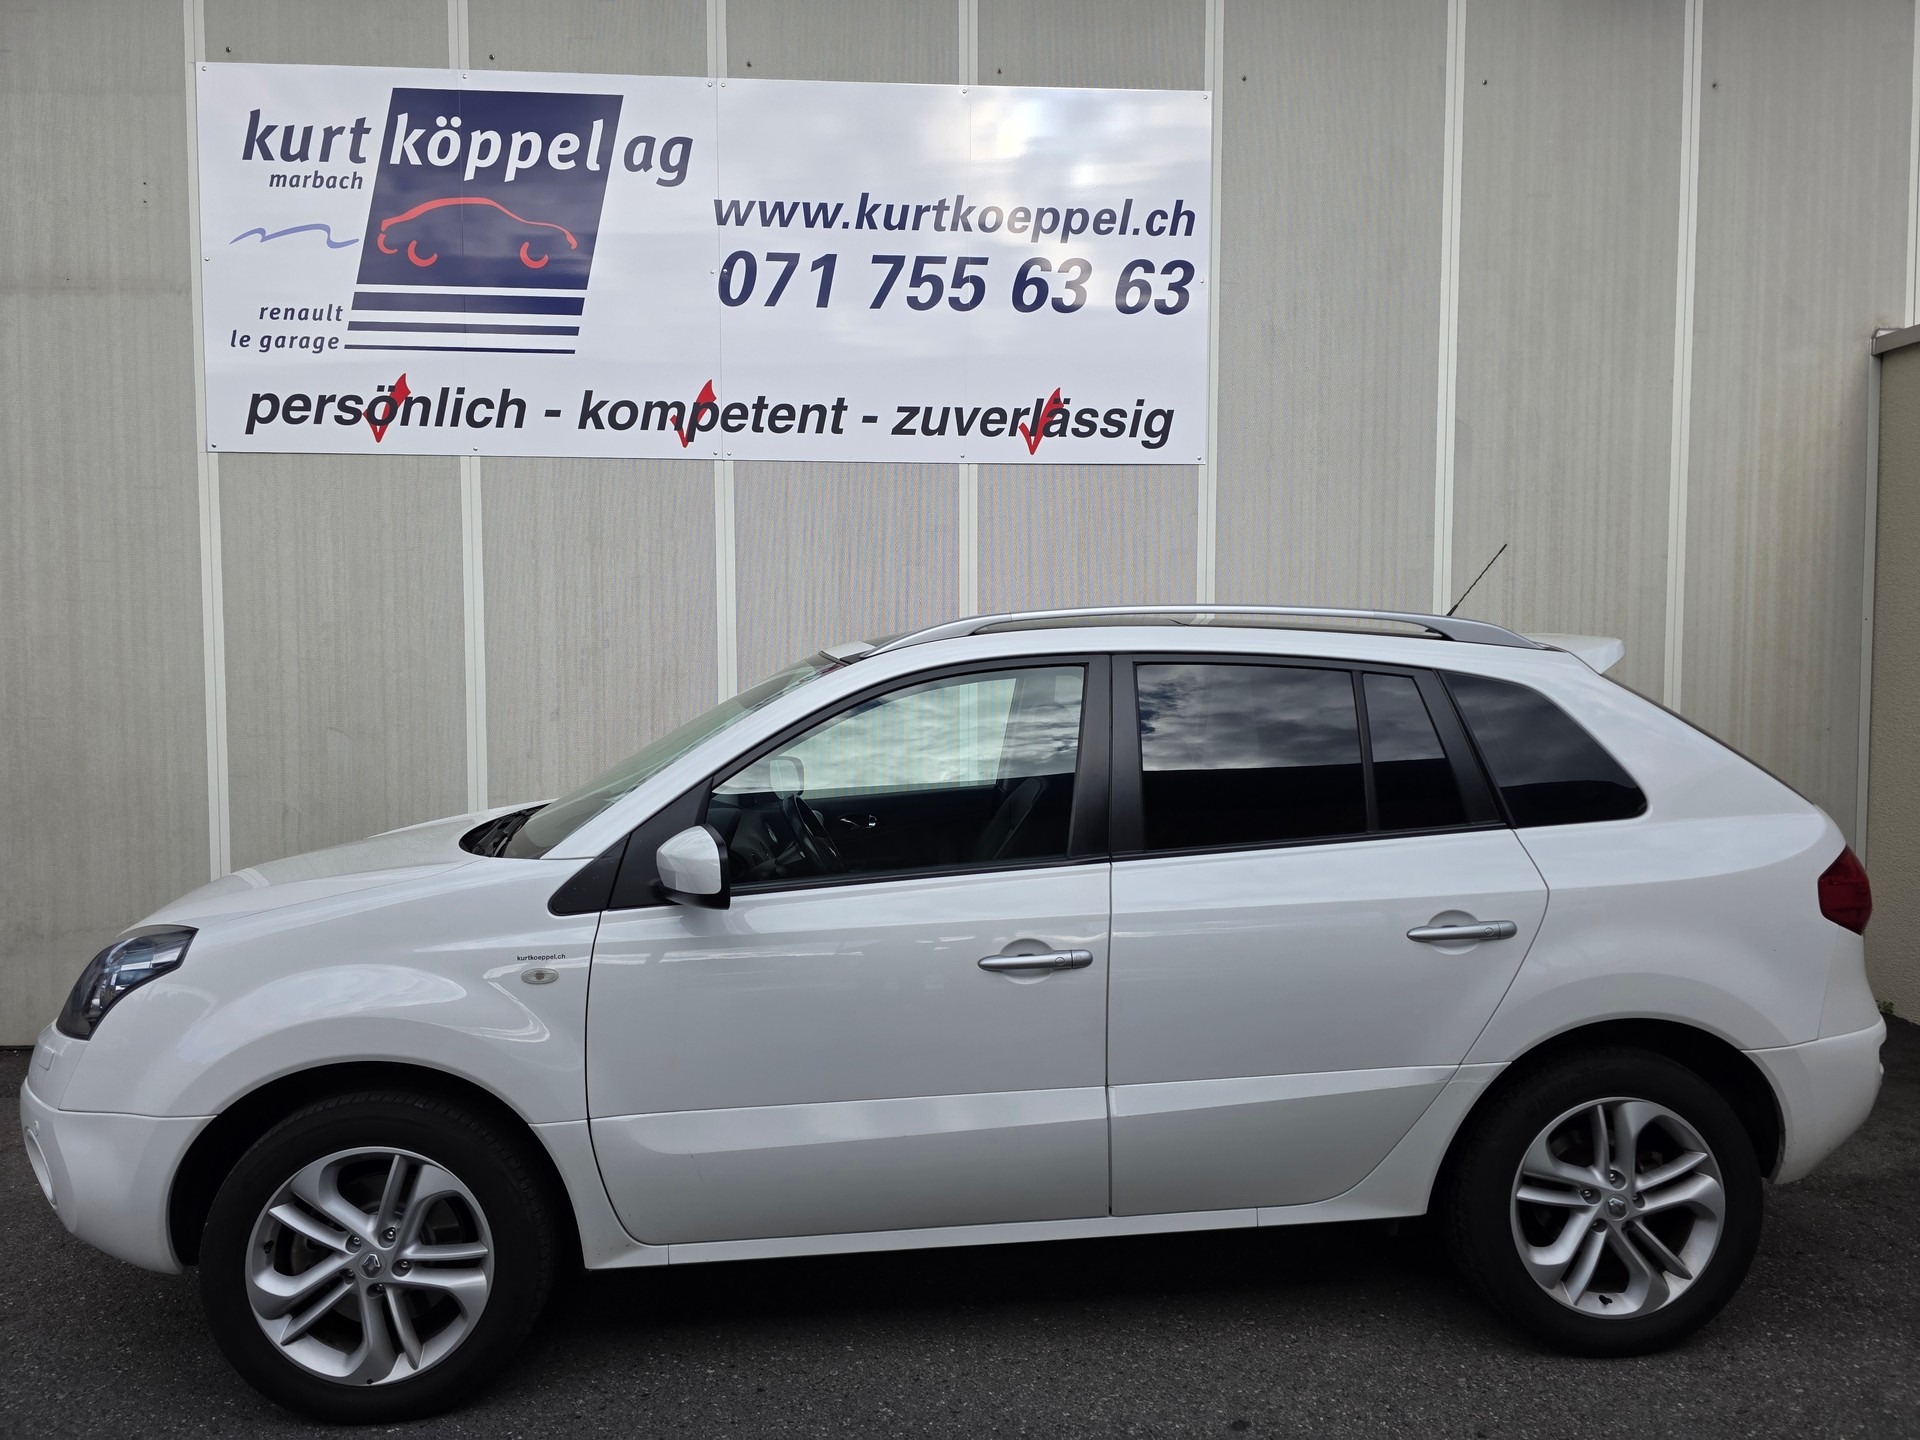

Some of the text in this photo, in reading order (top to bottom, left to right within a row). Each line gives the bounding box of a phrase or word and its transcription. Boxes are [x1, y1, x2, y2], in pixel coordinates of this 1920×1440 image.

[242, 109, 693, 187] kurt köppel ag
[268, 170, 363, 190] marbach
[714, 192, 1196, 243] www.kurtkoeppel.ch
[718, 250, 1195, 315] 071 755 63 63
[259, 303, 344, 322] renault
[230, 329, 340, 354] le garage
[245, 385, 527, 434] persönlich
[578, 390, 848, 443] kompetent
[891, 398, 1175, 449] zuverlässig
[517, 953, 566, 961] kurtkoeppel.ch
